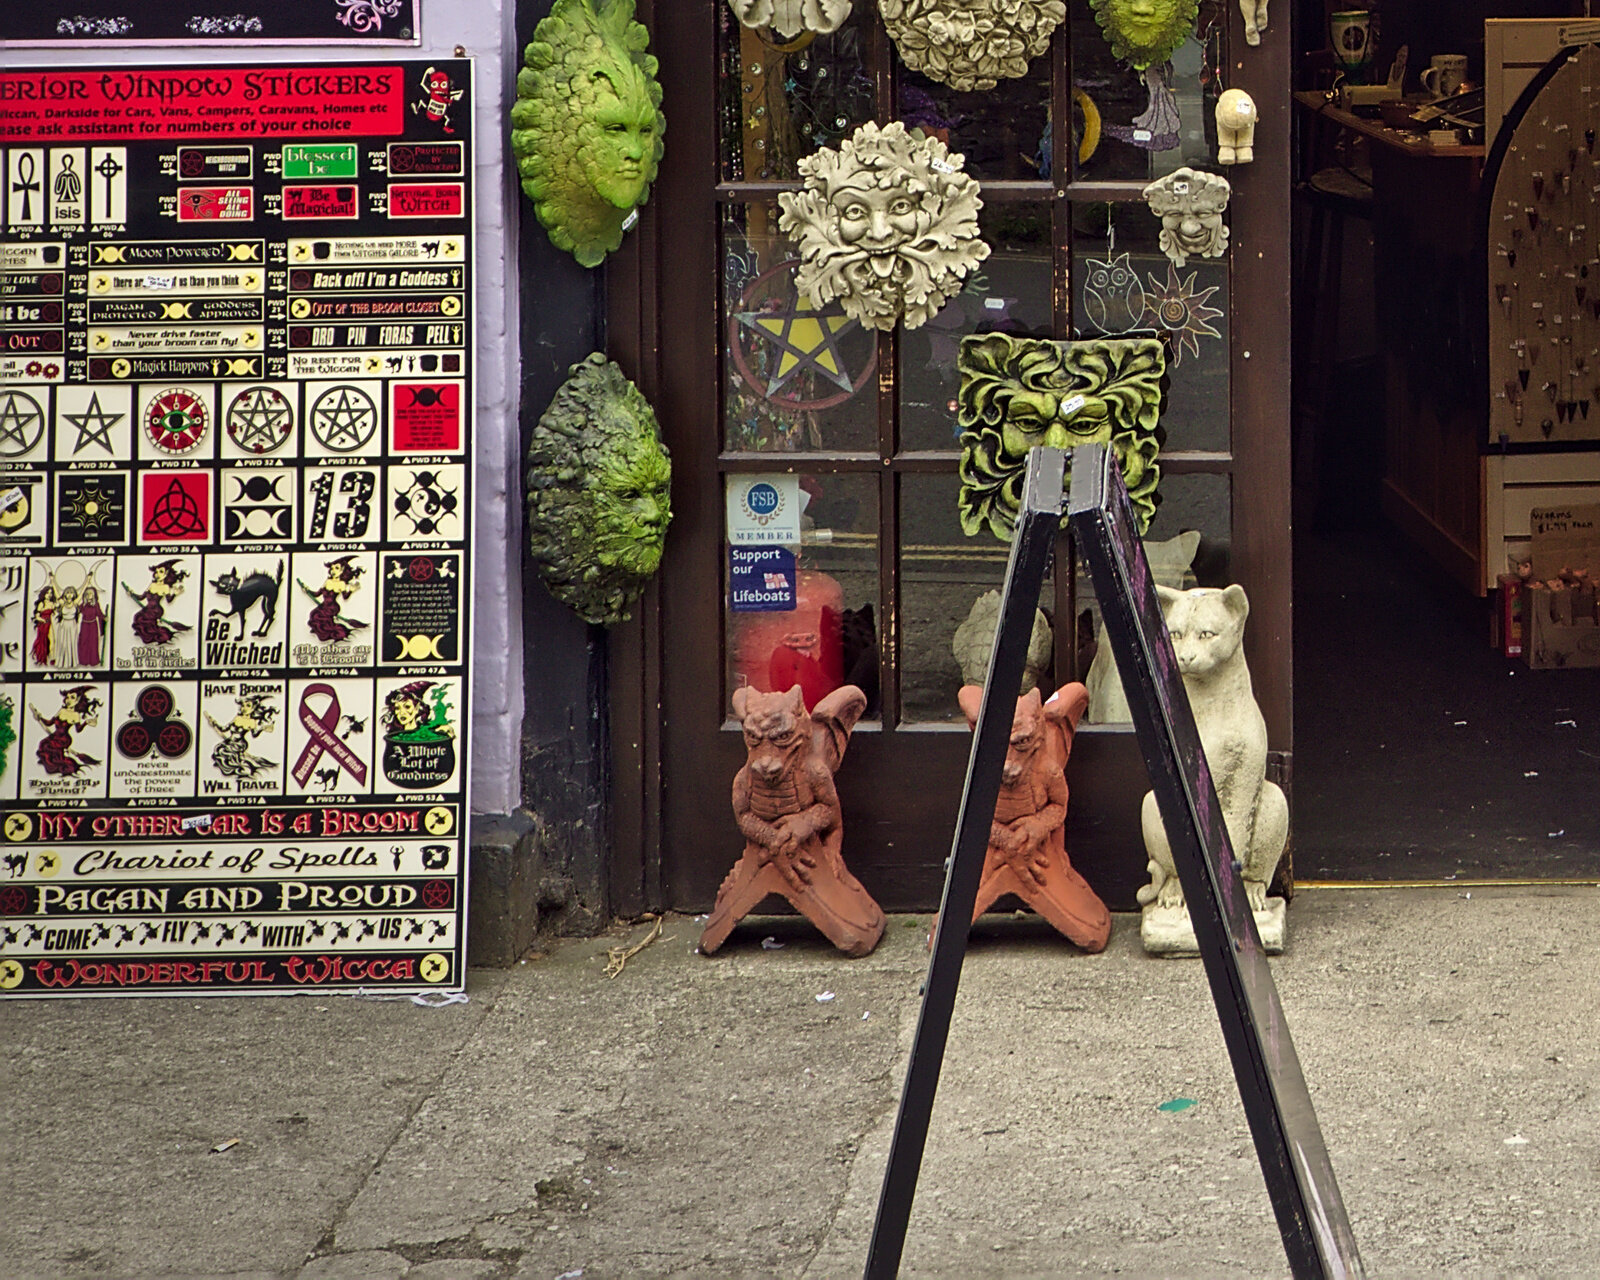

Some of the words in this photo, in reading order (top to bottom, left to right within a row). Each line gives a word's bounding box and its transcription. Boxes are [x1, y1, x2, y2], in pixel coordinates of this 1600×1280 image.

[45, 109, 99, 118] Darkside
[104, 108, 121, 118] for
[125, 108, 155, 118] Cars,
[160, 107, 193, 117] Vans,
[198, 105, 255, 117] Campers,
[259, 105, 318, 115] Caravans,
[323, 104, 365, 114] Homes
[370, 104, 387, 113] etc
[37, 123, 63, 134] ask
[68, 122, 134, 134] assistant
[140, 121, 161, 133] for
[167, 121, 235, 133] numbers
[240, 120, 257, 131] of
[260, 120, 298, 133] your
[302, 118, 351, 130] choice
[55, 207, 80, 218] isis
[313, 273, 342, 288] Back
[345, 272, 364, 287] off!
[367, 272, 386, 287] I'm
[389, 274, 396, 286] a
[400, 271, 448, 286] Goddess
[347, 327, 367, 345] PIN
[379, 326, 414, 345] FORAS
[426, 325, 449, 344] PELL
[309, 471, 376, 539] 13
[752, 492, 775, 506] FSB
[736, 532, 793, 540] MEMBER
[732, 550, 780, 562] Support
[733, 565, 753, 574] our
[733, 590, 790, 602] Lifeboats
[205, 619, 229, 641] Be
[206, 642, 283, 665] Witched
[74, 849, 214, 875] Chariot
[219, 847, 264, 873] of
[269, 846, 378, 873] Spells
[44, 929, 92, 950] COME
[162, 921, 189, 943] FLY
[262, 926, 304, 947] WITH
[379, 918, 402, 939] US
